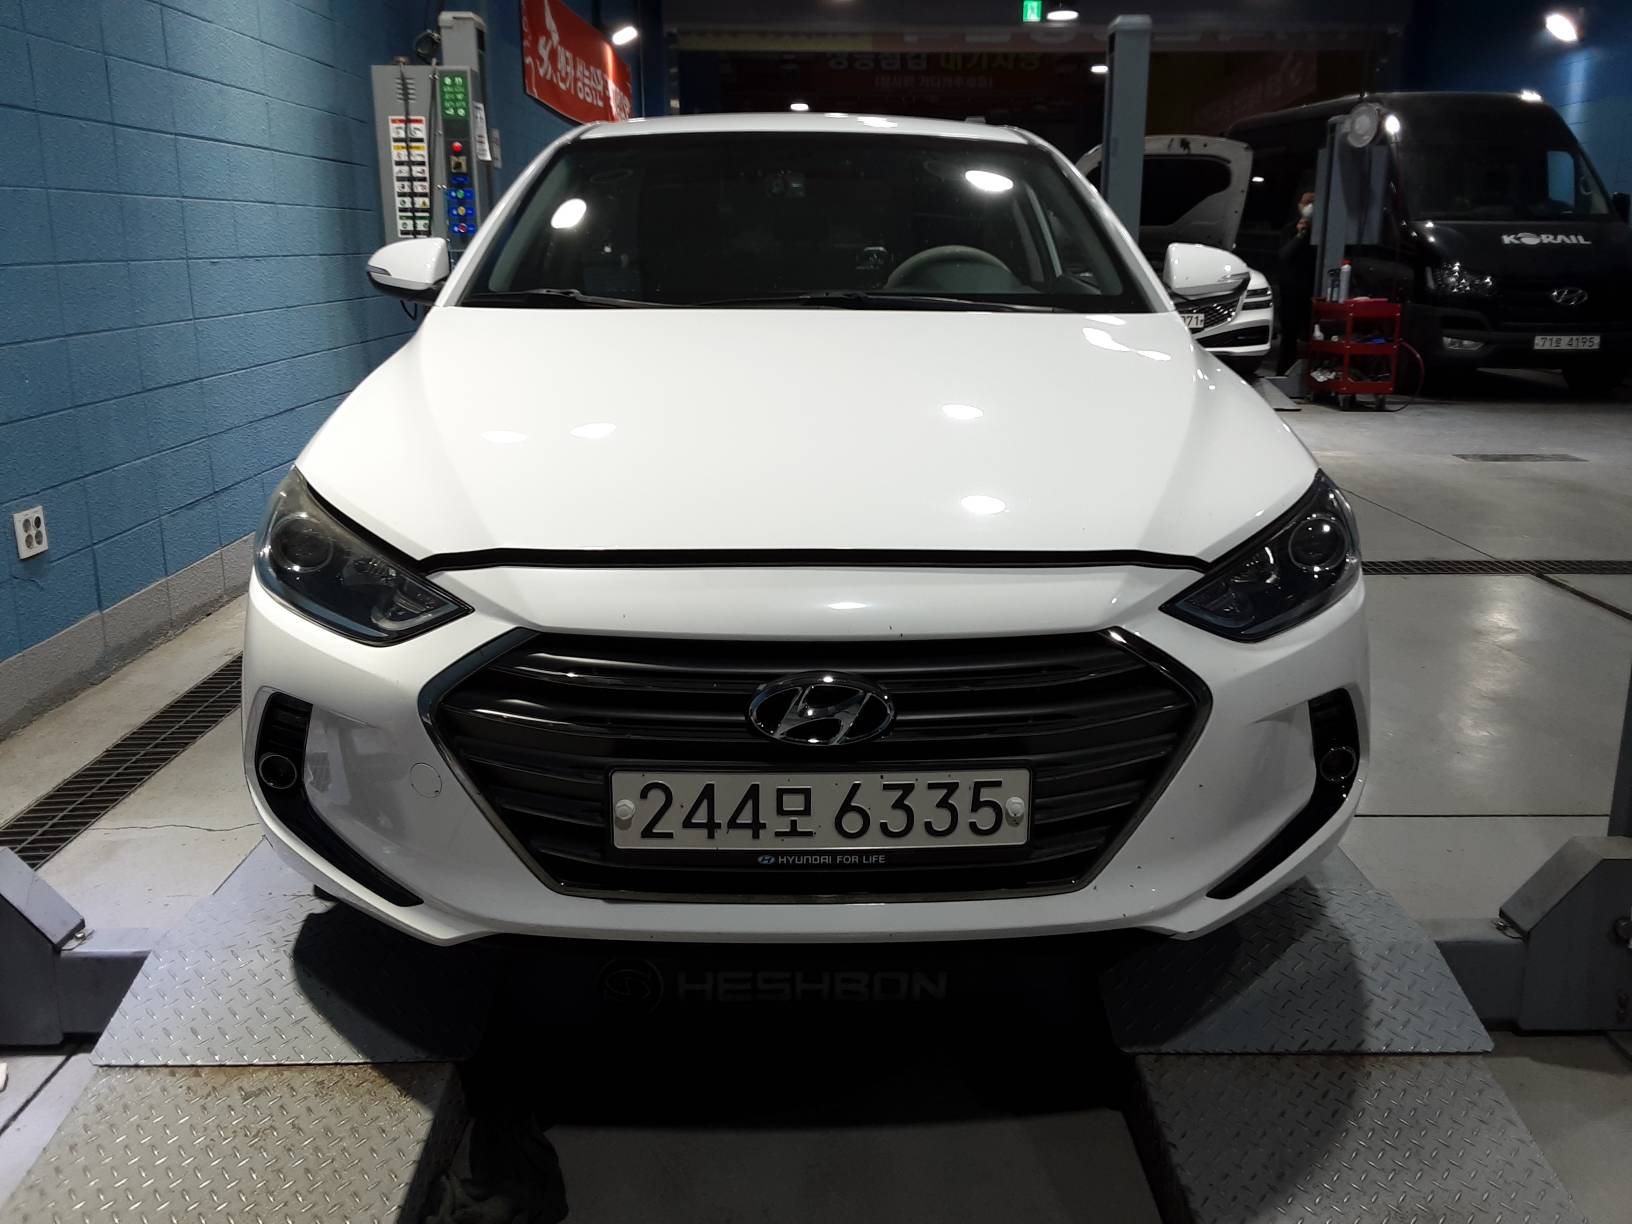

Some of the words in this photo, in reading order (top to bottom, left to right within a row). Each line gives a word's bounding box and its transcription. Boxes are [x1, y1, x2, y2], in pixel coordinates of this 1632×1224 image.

[1501, 232, 1593, 245] KORAIL
[639, 780, 815, 840] 244모
[834, 778, 1005, 840] 6335
[778, 855, 832, 865] HYUNDAI
[836, 855, 859, 865] FOR
[862, 854, 887, 864] LIFE
[675, 969, 950, 1003] HESHBON
